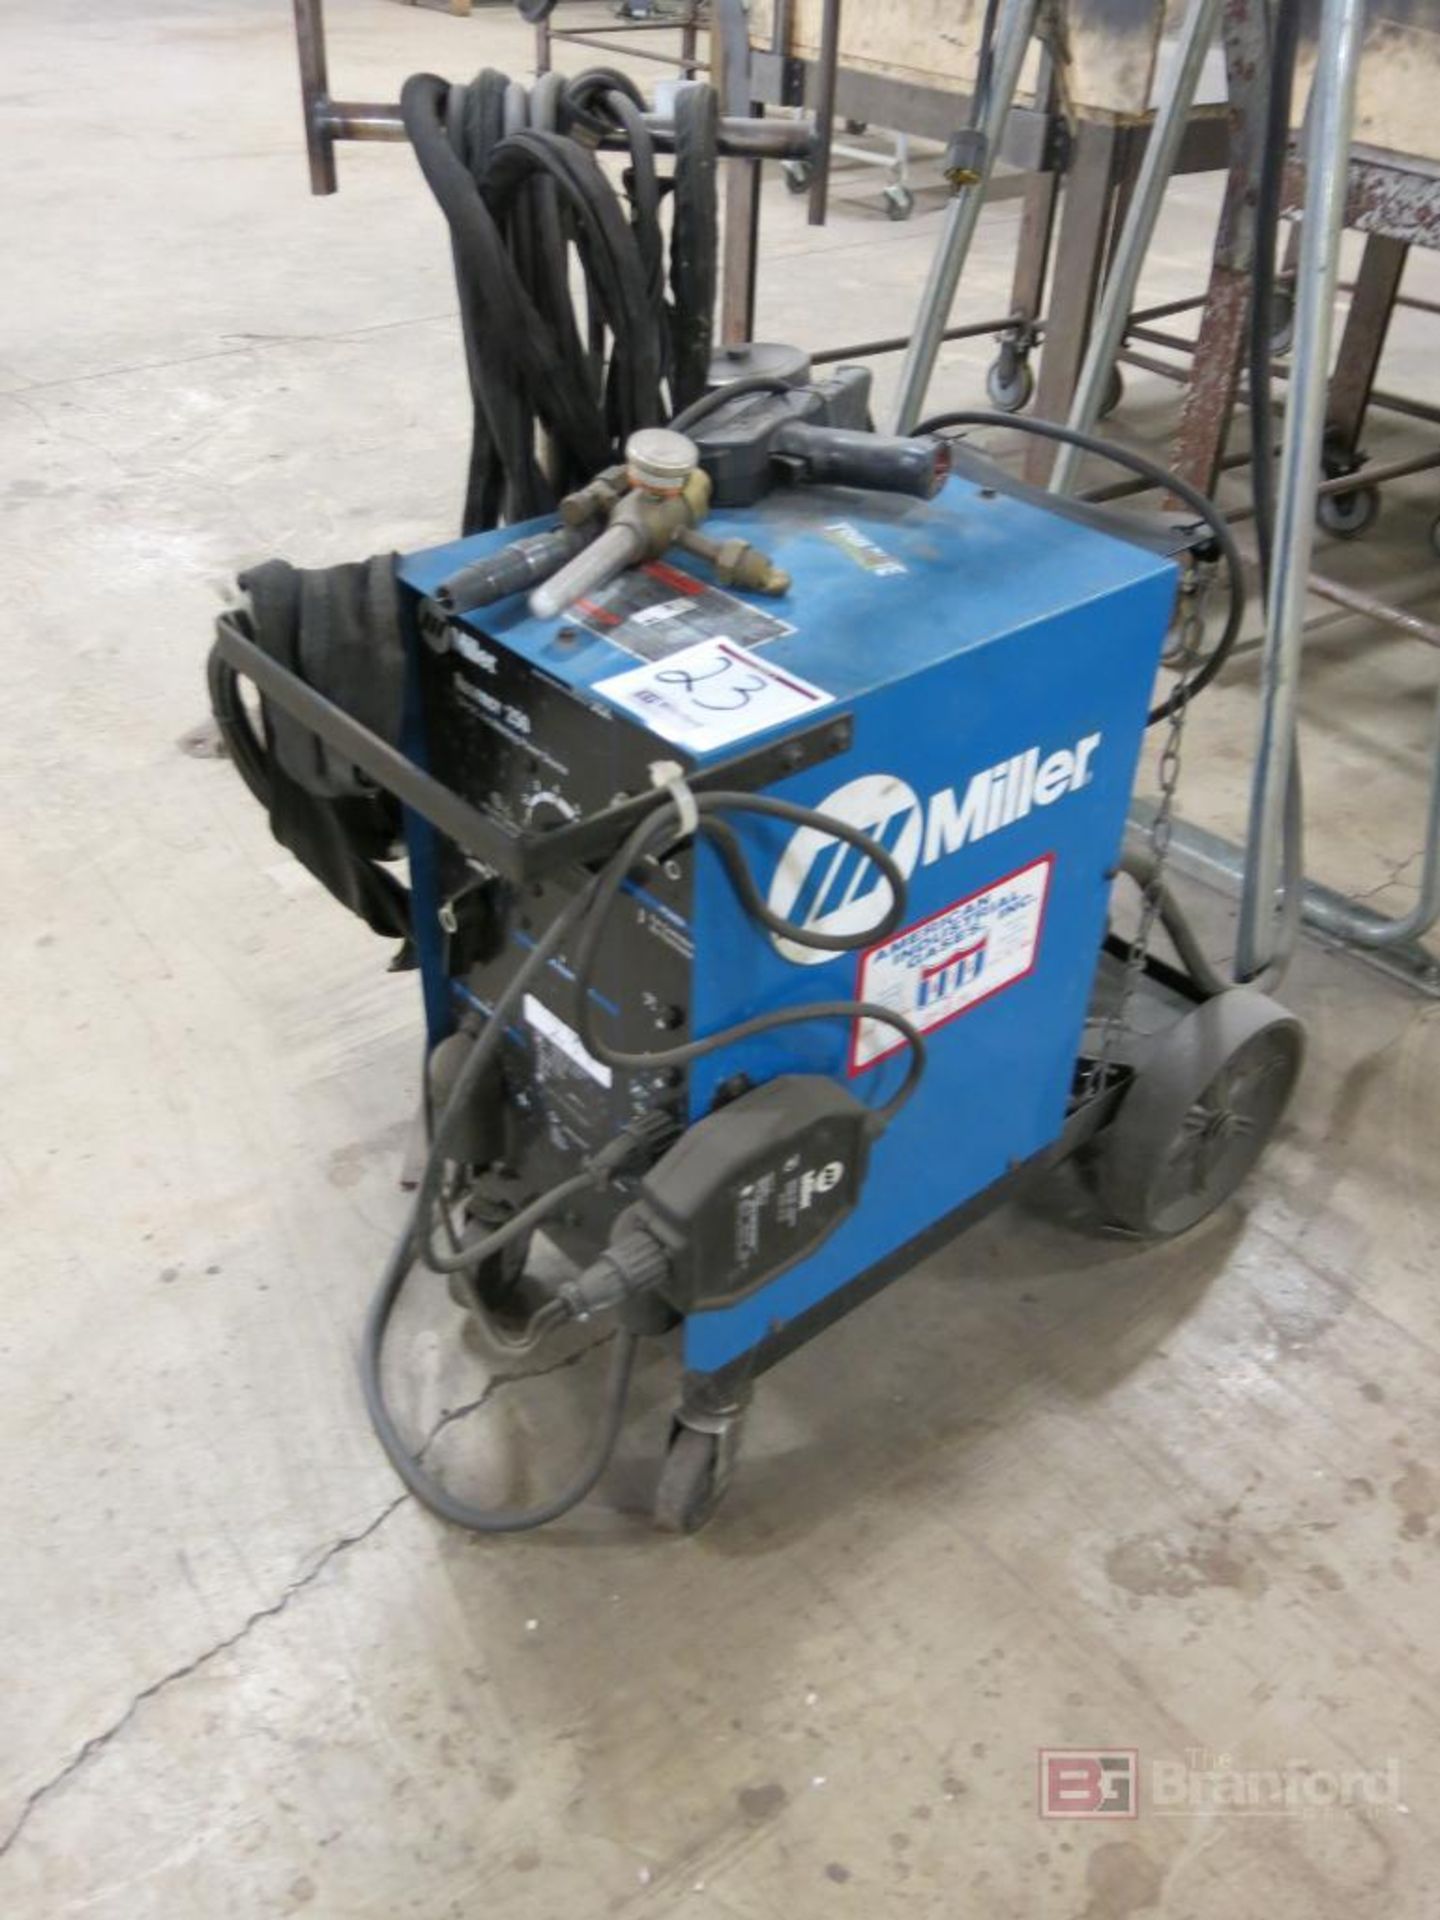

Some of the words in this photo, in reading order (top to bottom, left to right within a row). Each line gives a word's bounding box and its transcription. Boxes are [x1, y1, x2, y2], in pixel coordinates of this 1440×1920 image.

[655, 657, 769, 711] 23
[923, 731, 1101, 866] Miller
[873, 893, 991, 963] AMERICAN
[892, 891, 1024, 966] INDUSTRIAL
